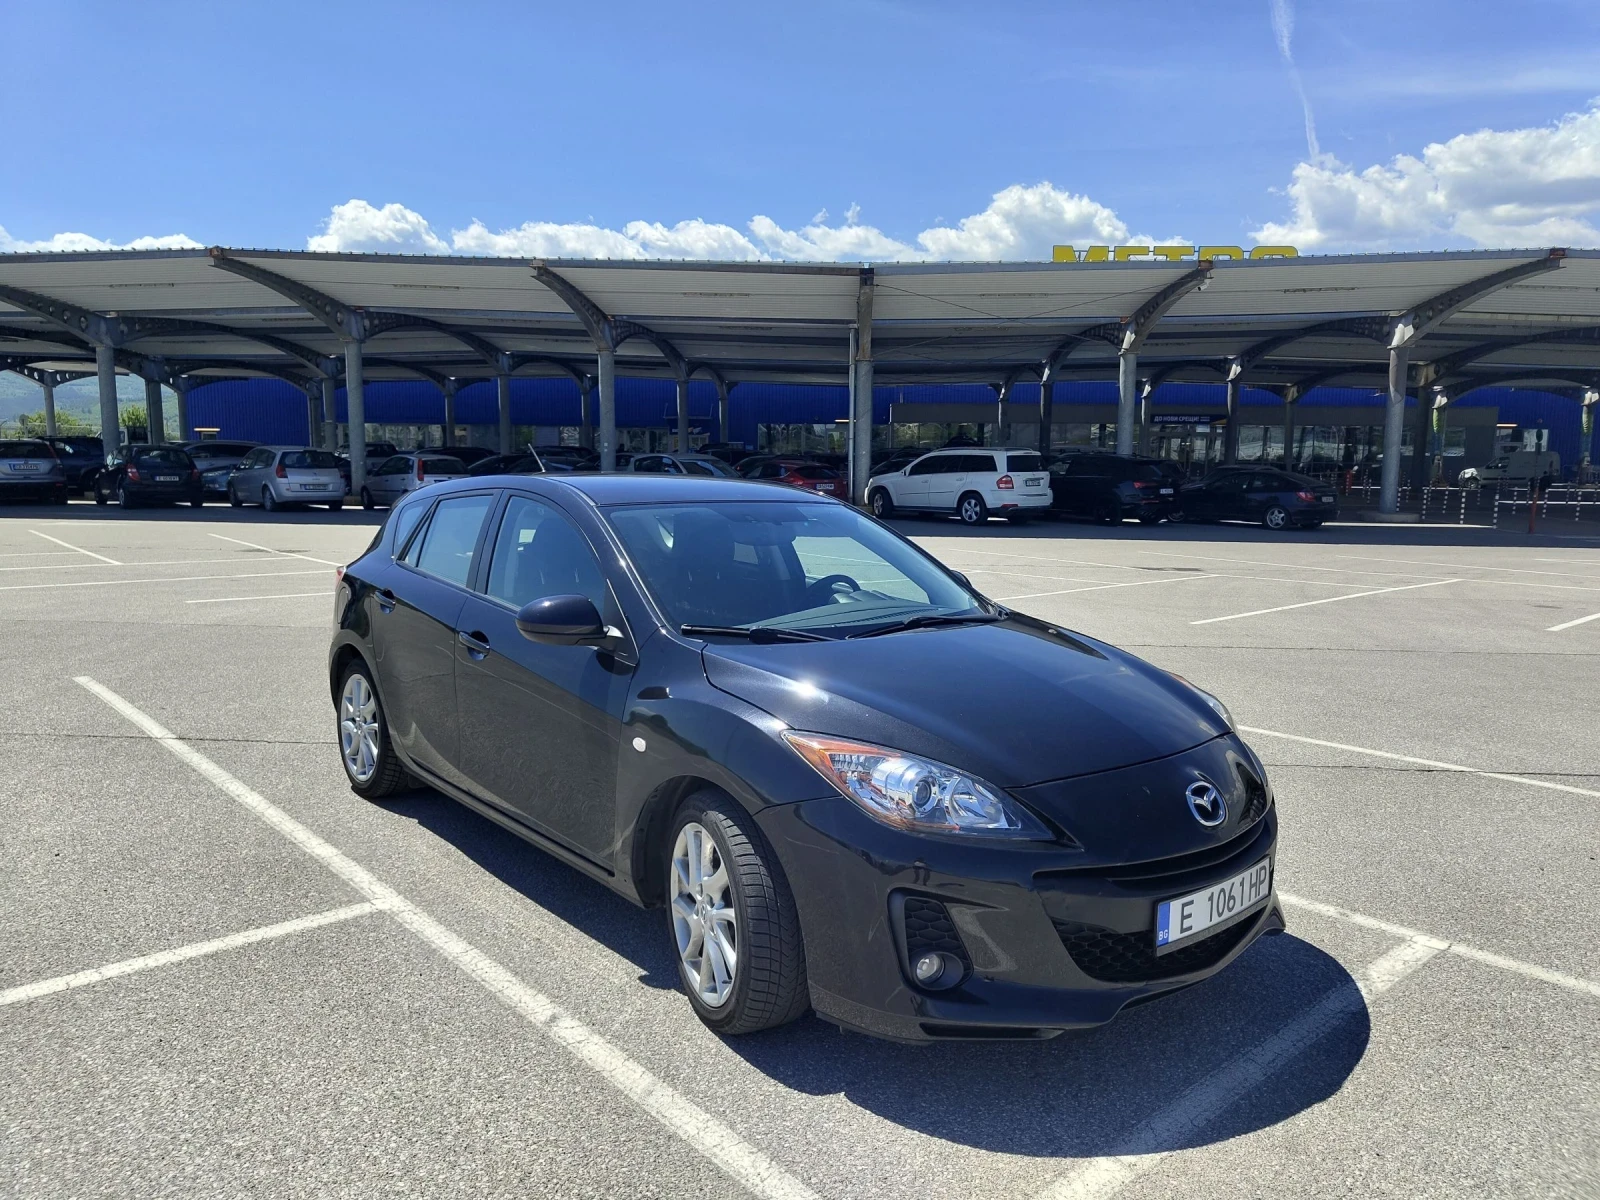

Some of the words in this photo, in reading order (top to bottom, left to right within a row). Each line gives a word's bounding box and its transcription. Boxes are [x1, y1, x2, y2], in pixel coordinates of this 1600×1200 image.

[1180, 899, 1194, 935] E
[1208, 876, 1245, 923] 1061
[1249, 865, 1267, 902] HP
[1158, 929, 1168, 941] BG
